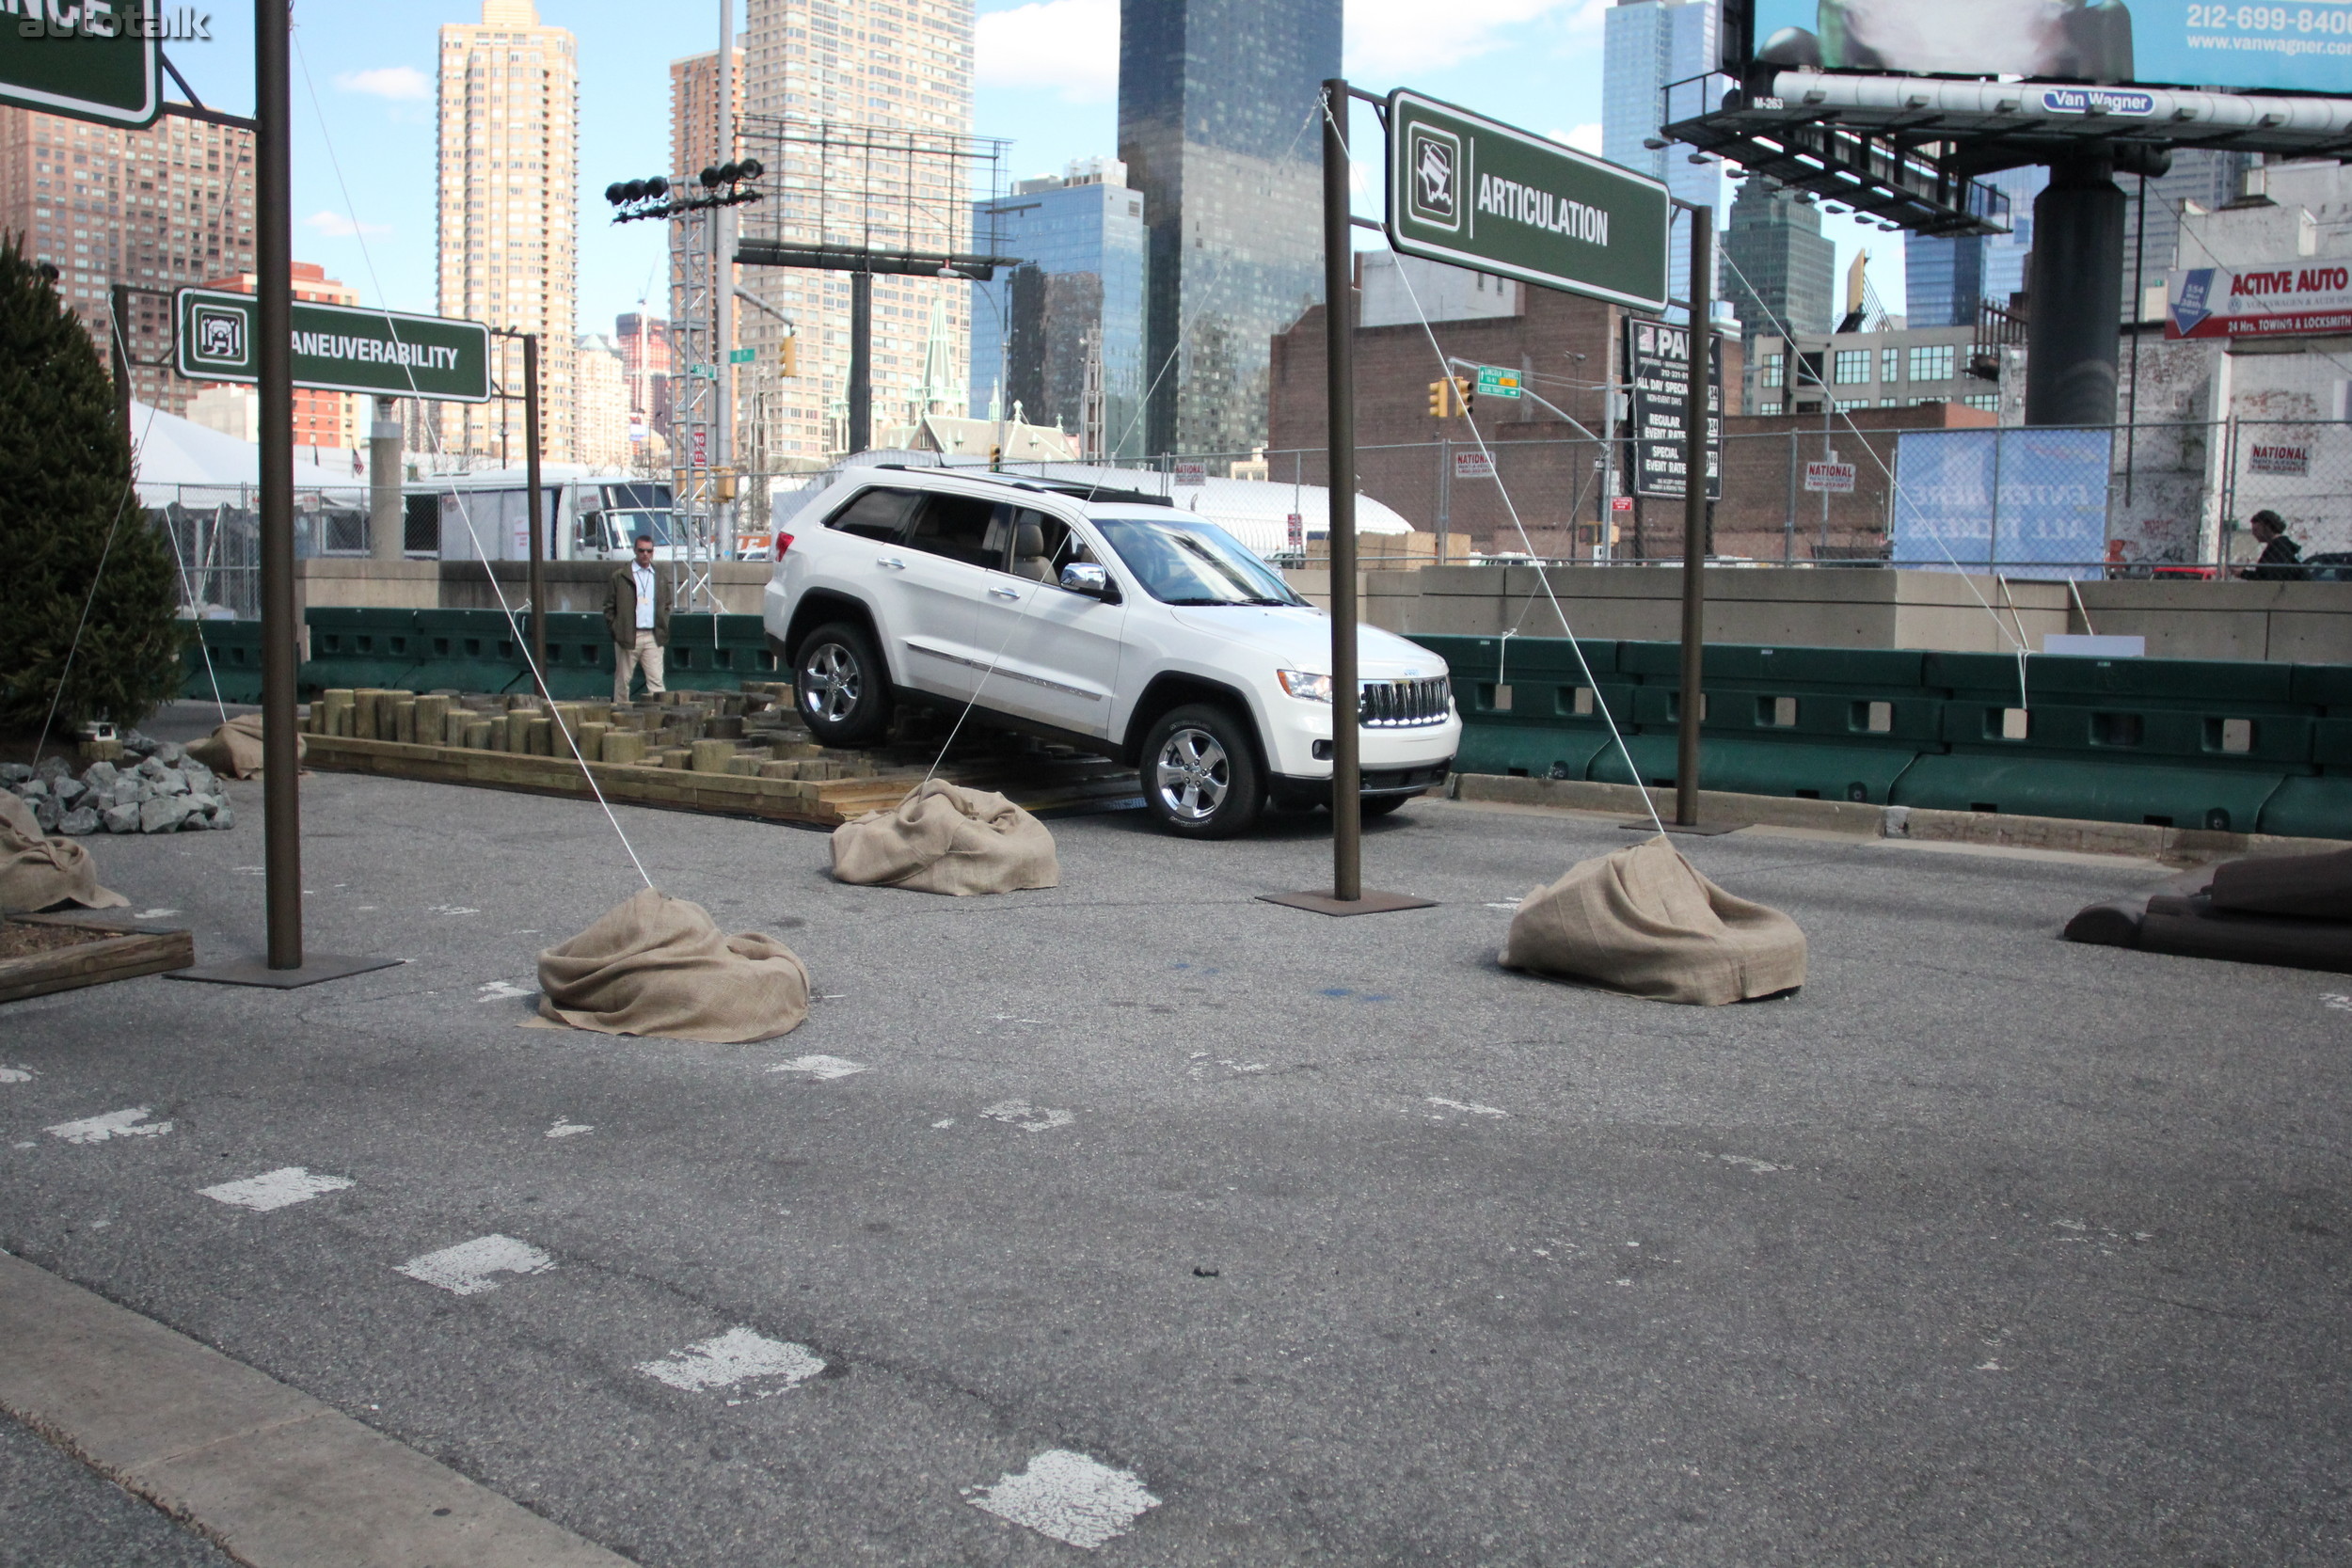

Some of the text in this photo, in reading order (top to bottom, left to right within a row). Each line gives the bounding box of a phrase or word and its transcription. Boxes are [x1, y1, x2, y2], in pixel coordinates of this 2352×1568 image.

[1754, 97, 1784, 110] M-263
[2052, 91, 2148, 113] Van Wagner
[1478, 172, 1609, 247] ARTICULATION
[2231, 267, 2349, 296] ACTIVE AUTO
[2247, 298, 2304, 309] VOLKSWAGEN
[2314, 295, 2335, 306] AUDI
[2228, 321, 2238, 333] 24
[2259, 317, 2292, 330] TOWING
[2304, 315, 2351, 329] LOCKSMITH
[292, 330, 458, 370] ANEUVERABILITY
[1637, 377, 1689, 396] ALL DAY SPECIA
[1649, 413, 1680, 428] REGULAR
[1645, 427, 1666, 438] EVENT
[1652, 445, 1679, 460] SPECIAL
[2253, 445, 2308, 460] NATIONAL
[1645, 459, 1667, 472] EVENT
[1809, 465, 1852, 477] NATIONAL
